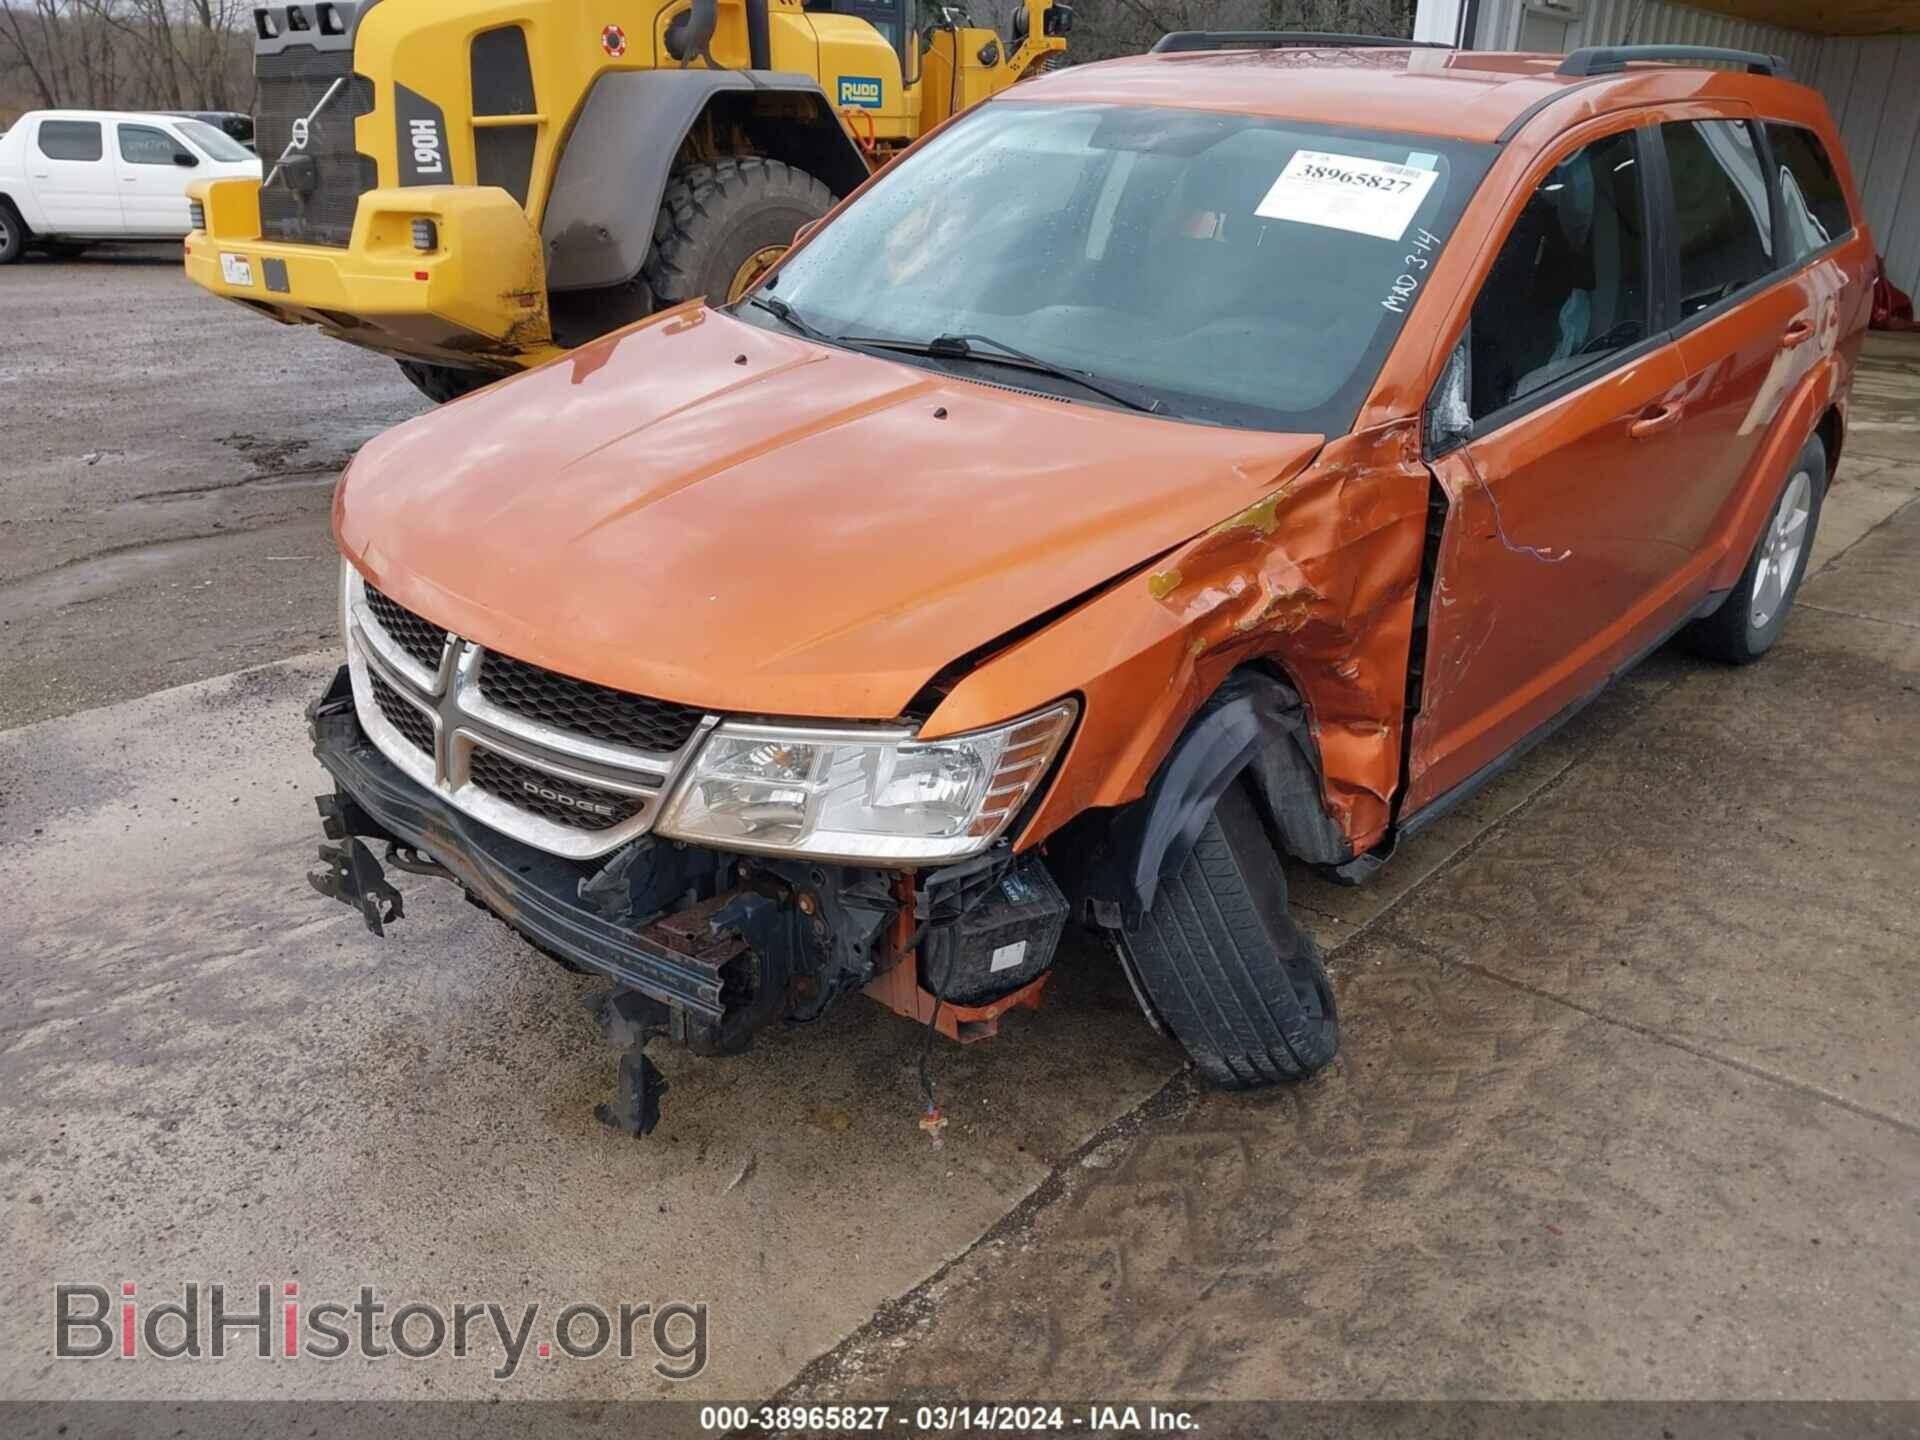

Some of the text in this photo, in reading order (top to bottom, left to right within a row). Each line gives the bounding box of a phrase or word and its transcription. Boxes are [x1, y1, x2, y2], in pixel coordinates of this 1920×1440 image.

[841, 82, 879, 101] RUDD
[409, 119, 443, 173] L90H
[1297, 163, 1412, 194] 38965827
[1405, 227, 1441, 270] 3-14
[523, 782, 614, 816] DODGE
